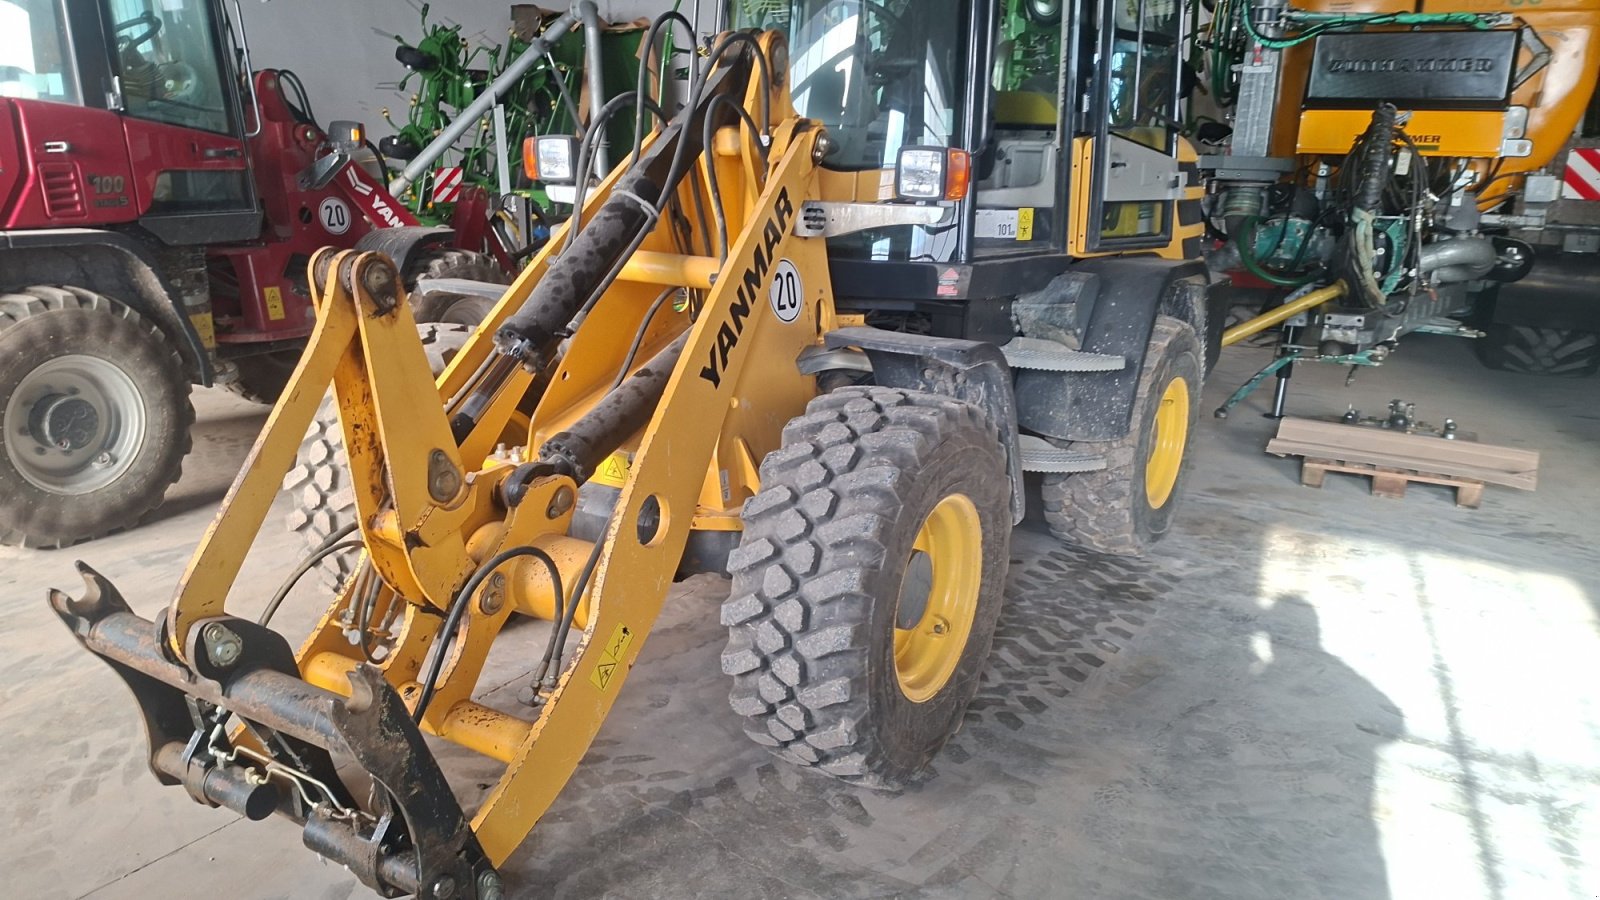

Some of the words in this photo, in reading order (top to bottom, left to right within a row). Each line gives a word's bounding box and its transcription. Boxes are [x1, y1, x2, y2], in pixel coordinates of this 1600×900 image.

[325, 204, 346, 227] 20
[998, 223, 1011, 236] 101
[699, 186, 794, 390] YANMAR
[774, 271, 798, 311] 20
